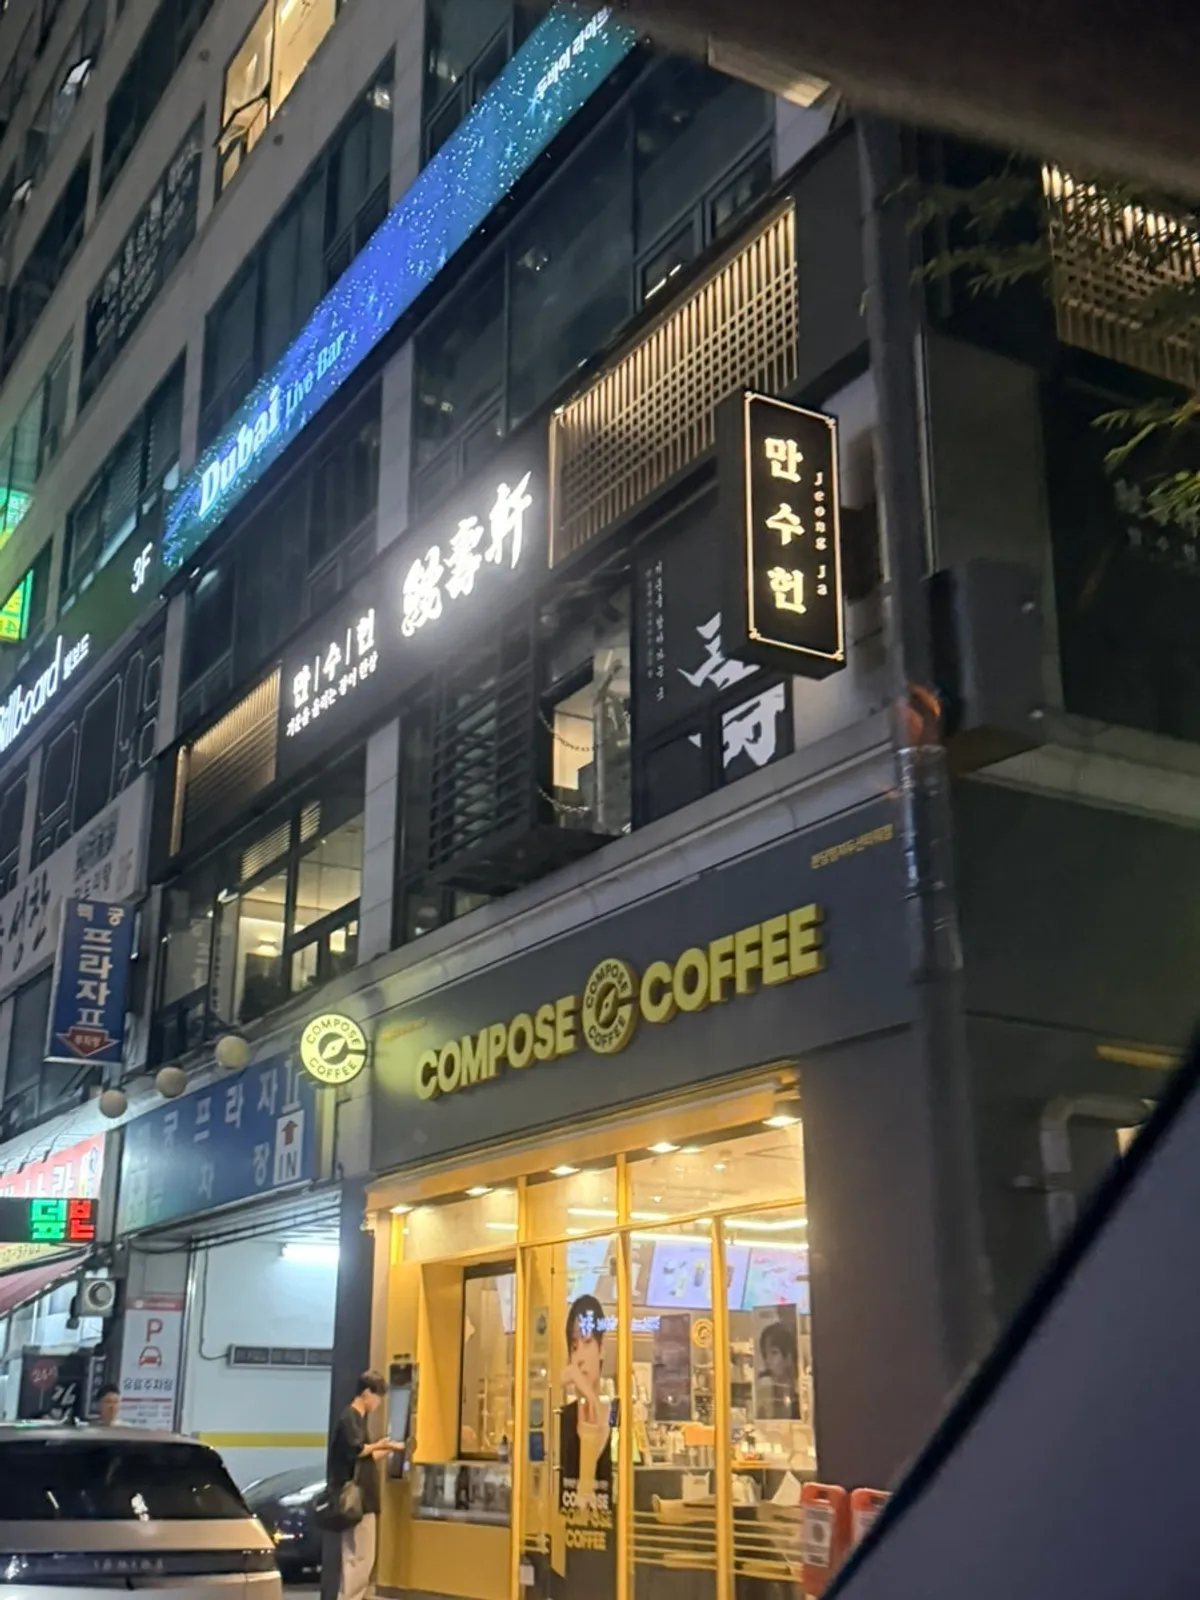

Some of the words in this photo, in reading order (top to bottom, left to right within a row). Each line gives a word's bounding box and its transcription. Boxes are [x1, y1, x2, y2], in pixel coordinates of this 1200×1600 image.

[535, 44, 571, 100] 두바이
[199, 385, 281, 518] Dubai
[285, 371, 314, 419] Live
[316, 330, 347, 381] Bar
[813, 471, 828, 551] Jeong
[131, 542, 153, 593] 3F
[816, 564, 829, 596] Ja
[414, 994, 578, 1101] COMPOSE
[640, 903, 826, 1024] COFFEE
[585, 963, 630, 1010] COMPOSE
[306, 1018, 361, 1045] COMPOSE
[588, 1013, 627, 1047] COFFEE
[308, 1057, 358, 1079] COFFEE
[277, 1150, 299, 1182] IN
[144, 1318, 164, 1343] P
